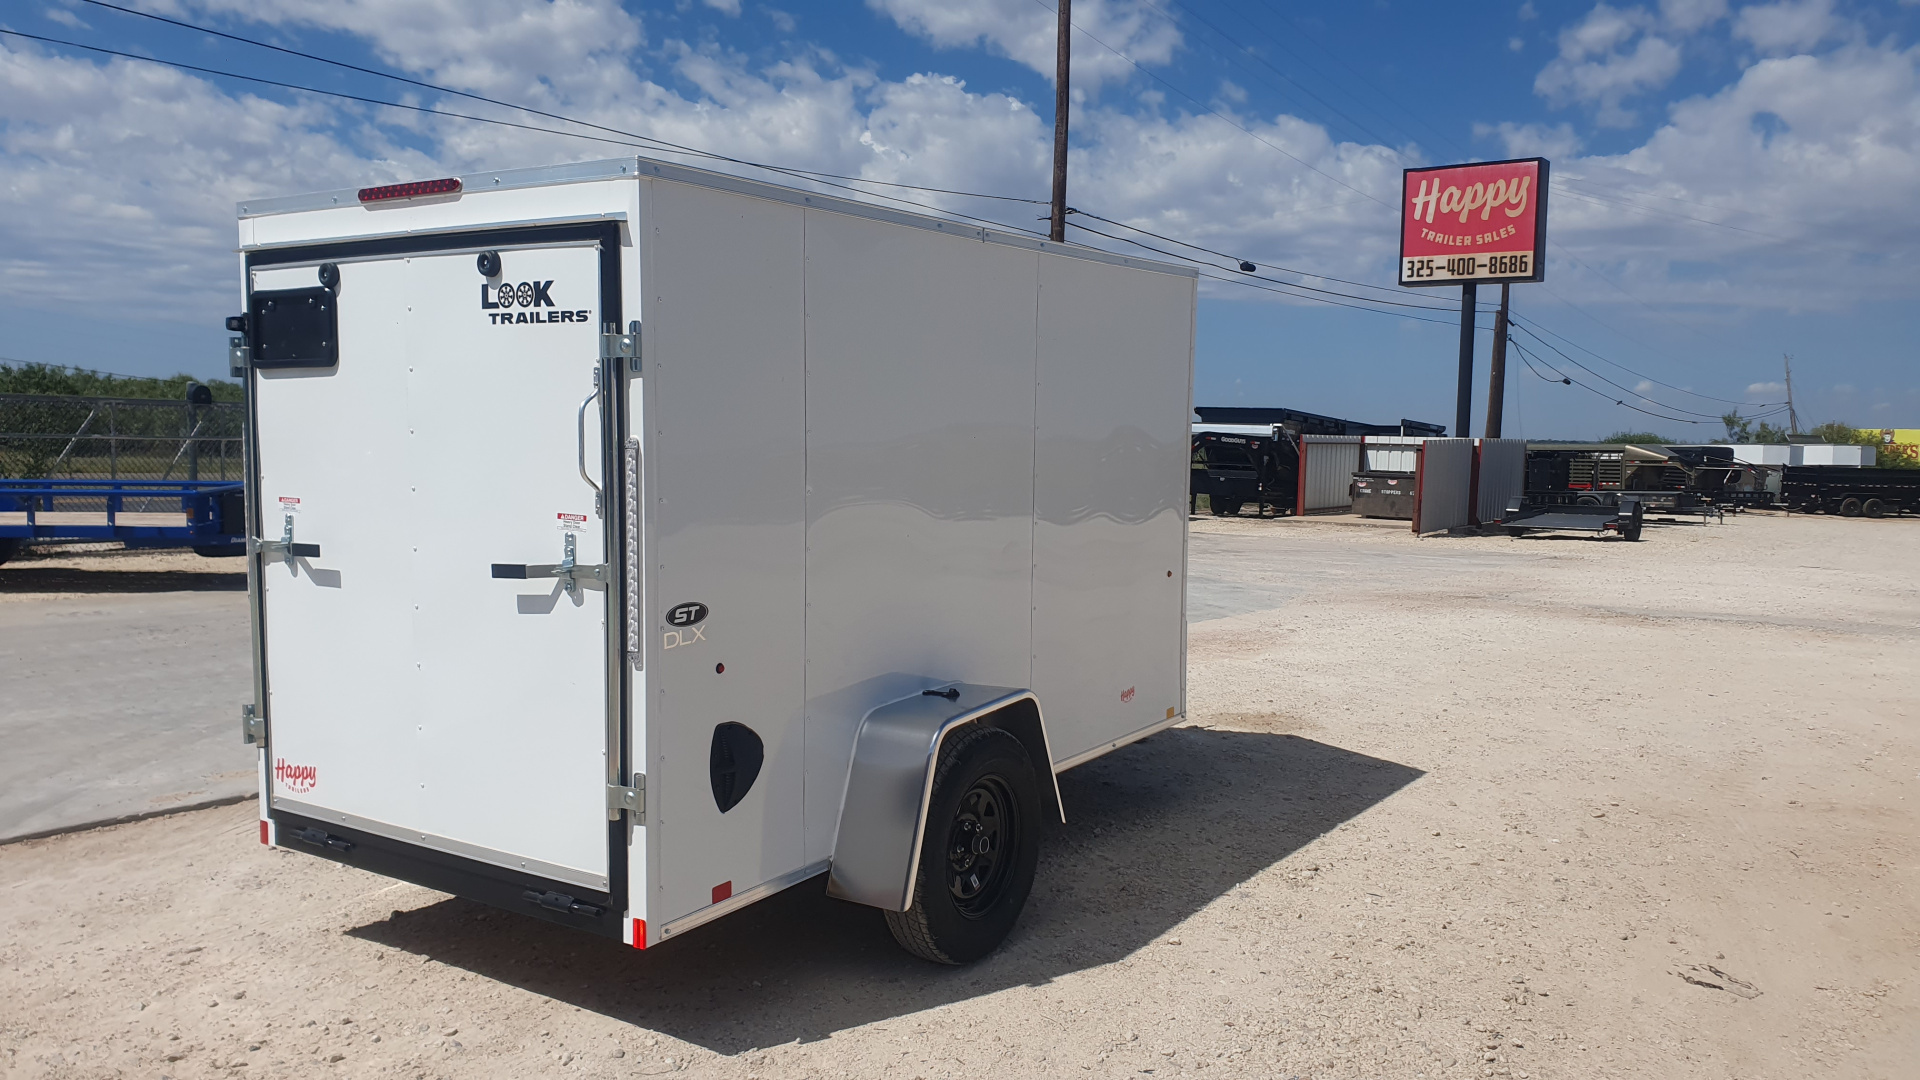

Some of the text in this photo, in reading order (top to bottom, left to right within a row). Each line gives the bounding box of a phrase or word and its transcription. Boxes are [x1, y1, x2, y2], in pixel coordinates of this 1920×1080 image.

[1412, 176, 1531, 224] Happy
[1421, 224, 1516, 246] TRAILER SALES
[1407, 255, 1528, 278] 325-400-8686
[481, 280, 555, 309] LOOK
[488, 310, 589, 325] TRAILERS
[674, 605, 700, 624] ST
[664, 625, 706, 649] DLX
[275, 757, 316, 788] Happy
